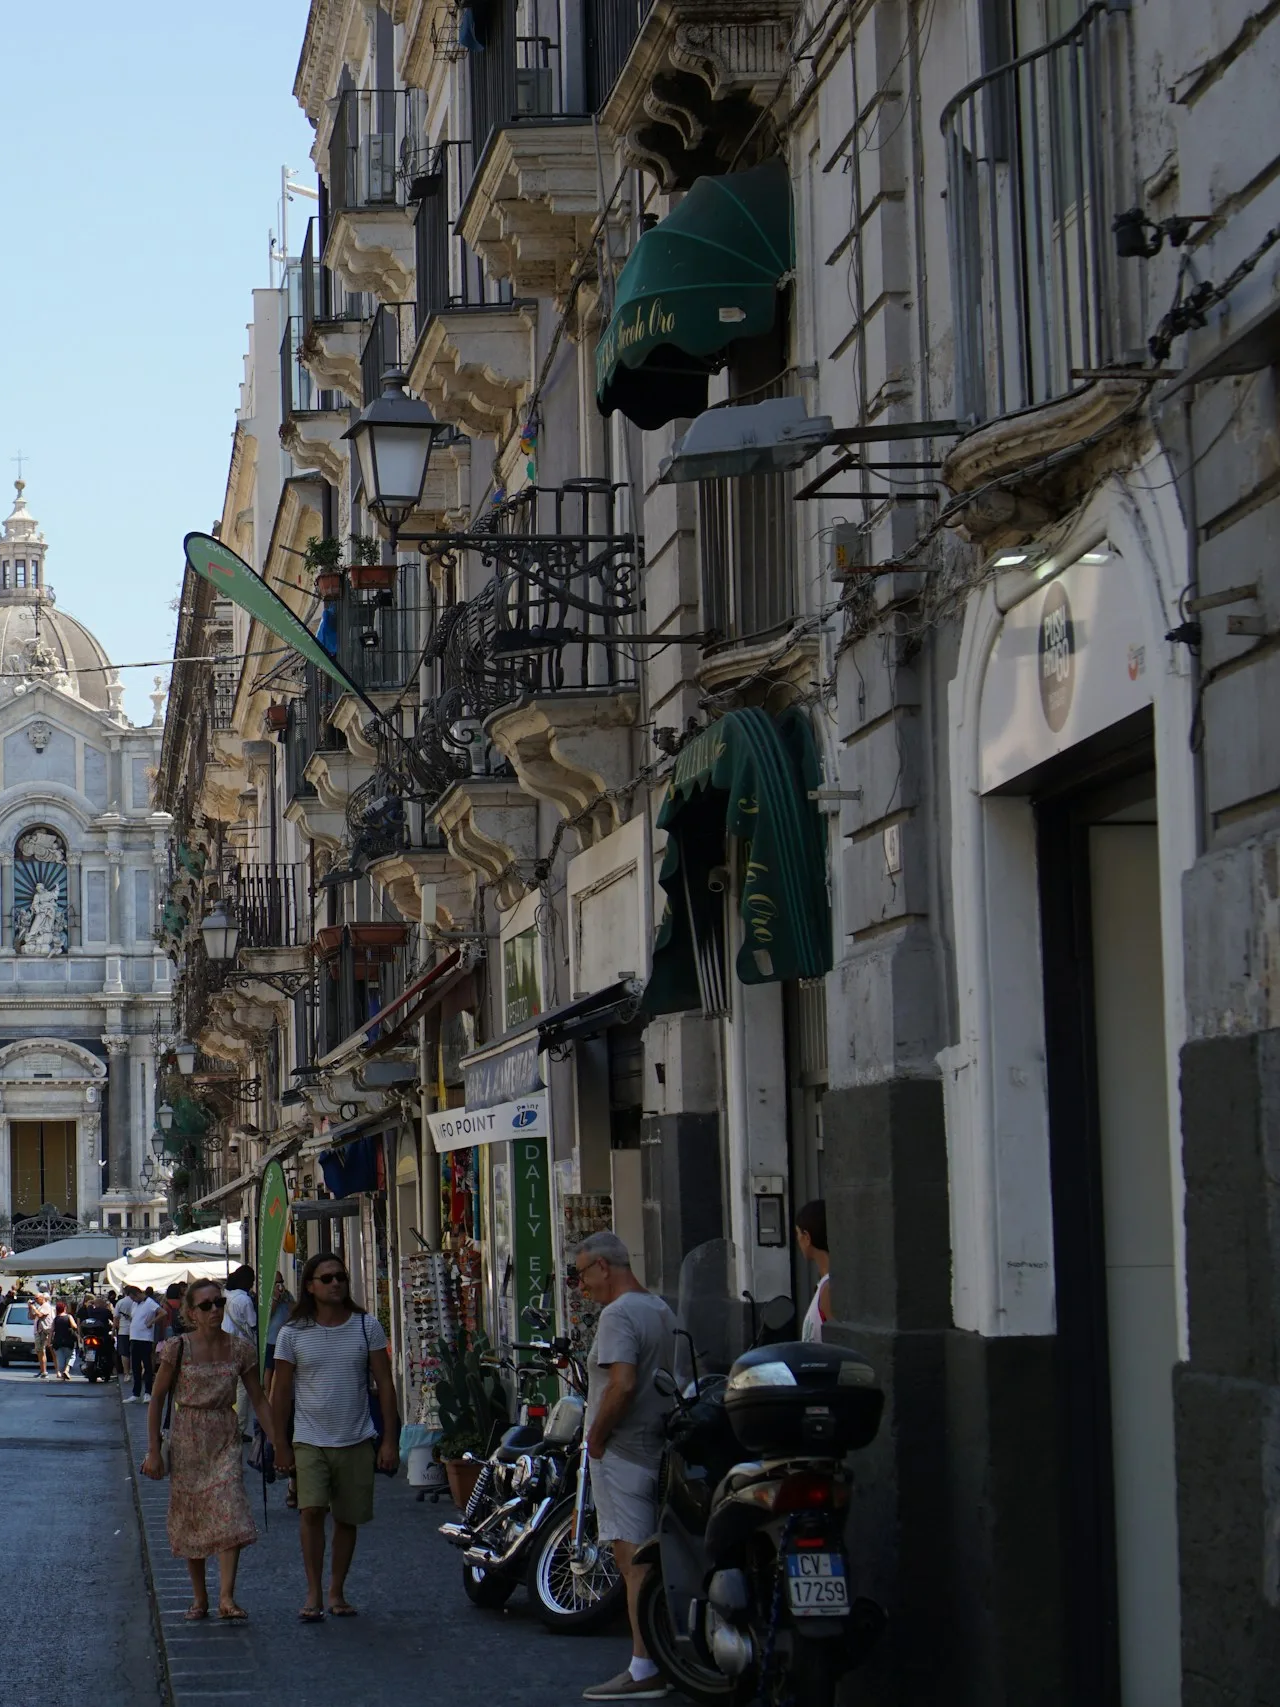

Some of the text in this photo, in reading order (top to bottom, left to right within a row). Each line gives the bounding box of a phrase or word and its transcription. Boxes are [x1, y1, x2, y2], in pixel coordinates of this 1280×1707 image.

[649, 298, 675, 337] Oro
[1044, 605, 1066, 649] PUSH
[1056, 637, 1069, 682] GO
[455, 1114, 496, 1135] POINT
[525, 1145, 541, 1238] DAILY
[800, 1555, 820, 1575] CV
[794, 1582, 846, 1602] 17259
